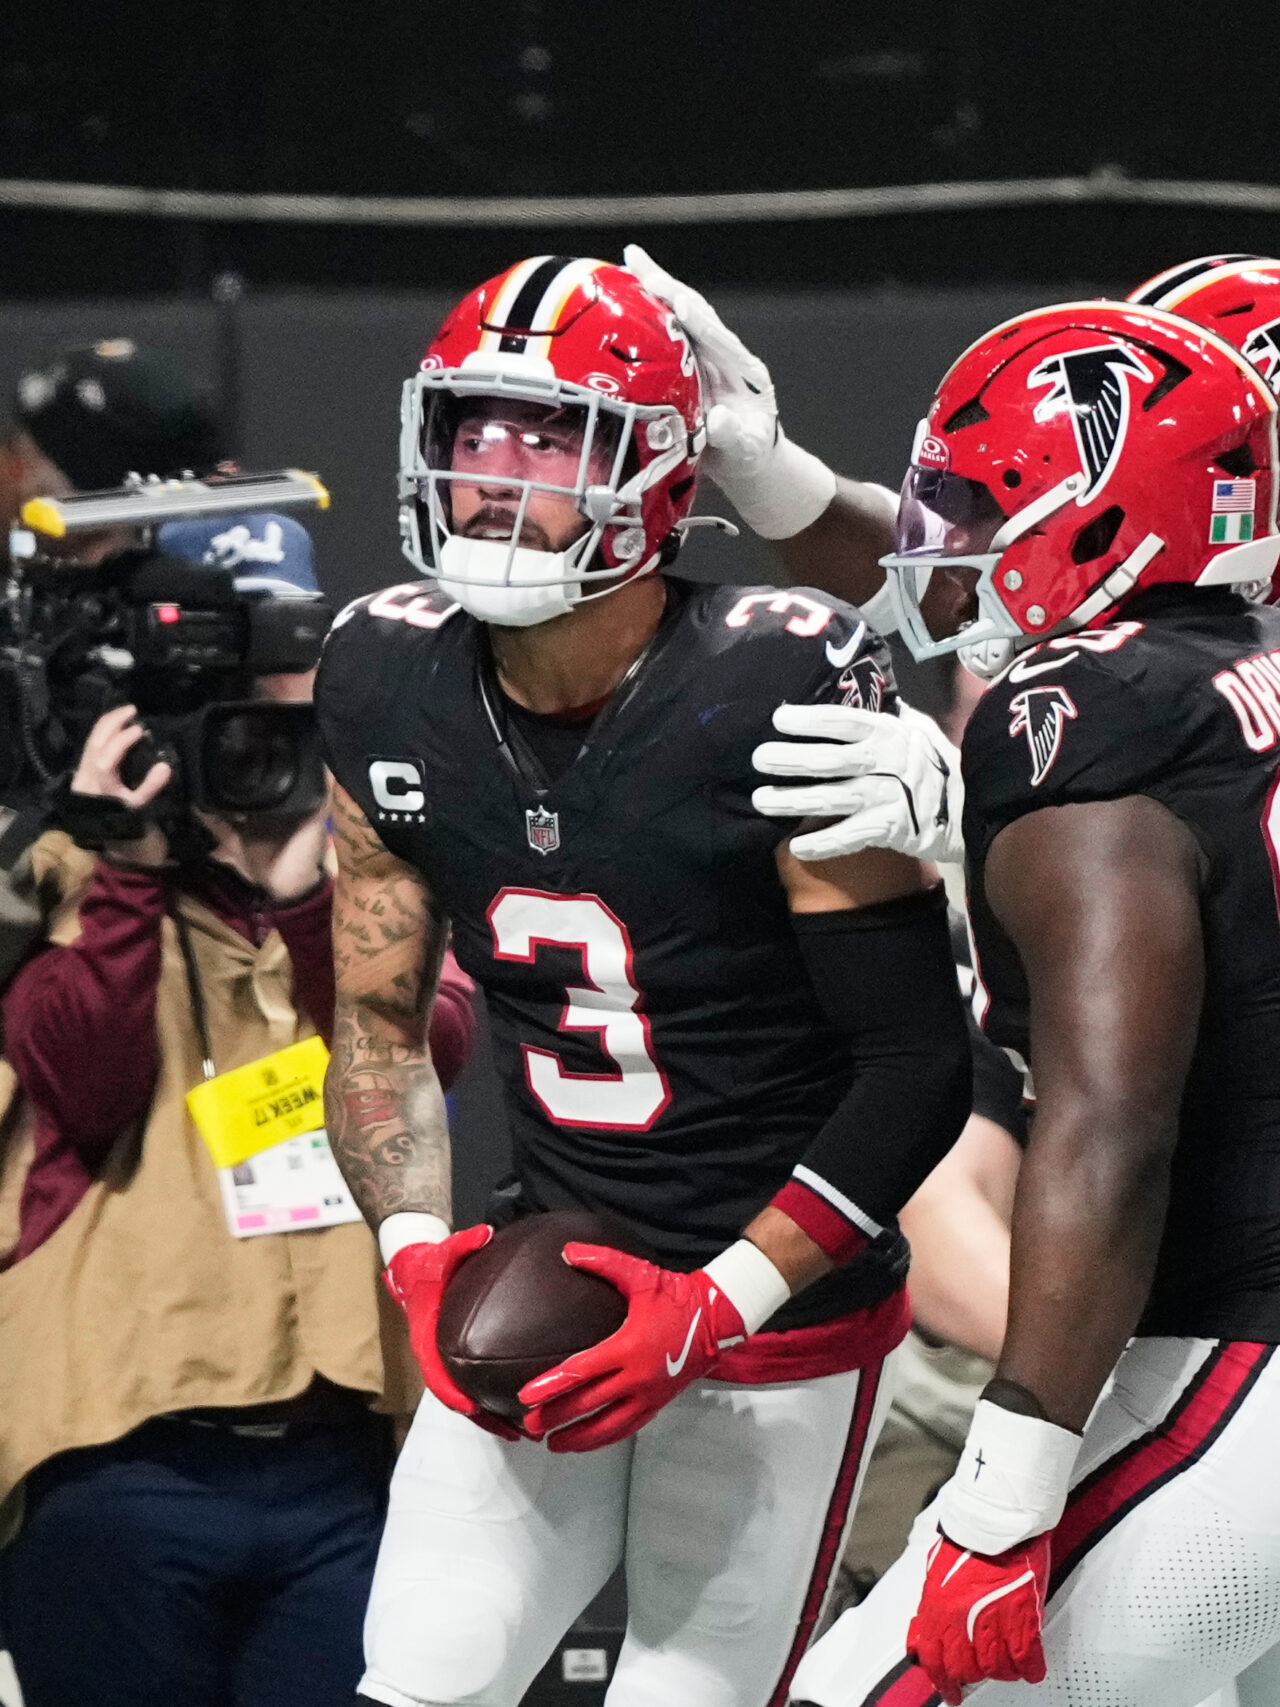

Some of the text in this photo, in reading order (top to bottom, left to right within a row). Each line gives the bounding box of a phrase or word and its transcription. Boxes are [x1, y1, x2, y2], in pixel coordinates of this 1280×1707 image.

[367, 583, 463, 629] 3
[725, 592, 834, 637] 3
[368, 761, 425, 811] C
[532, 827, 557, 846] NFL
[487, 887, 672, 1131] 3
[270, 1085, 320, 1118] WEEK
